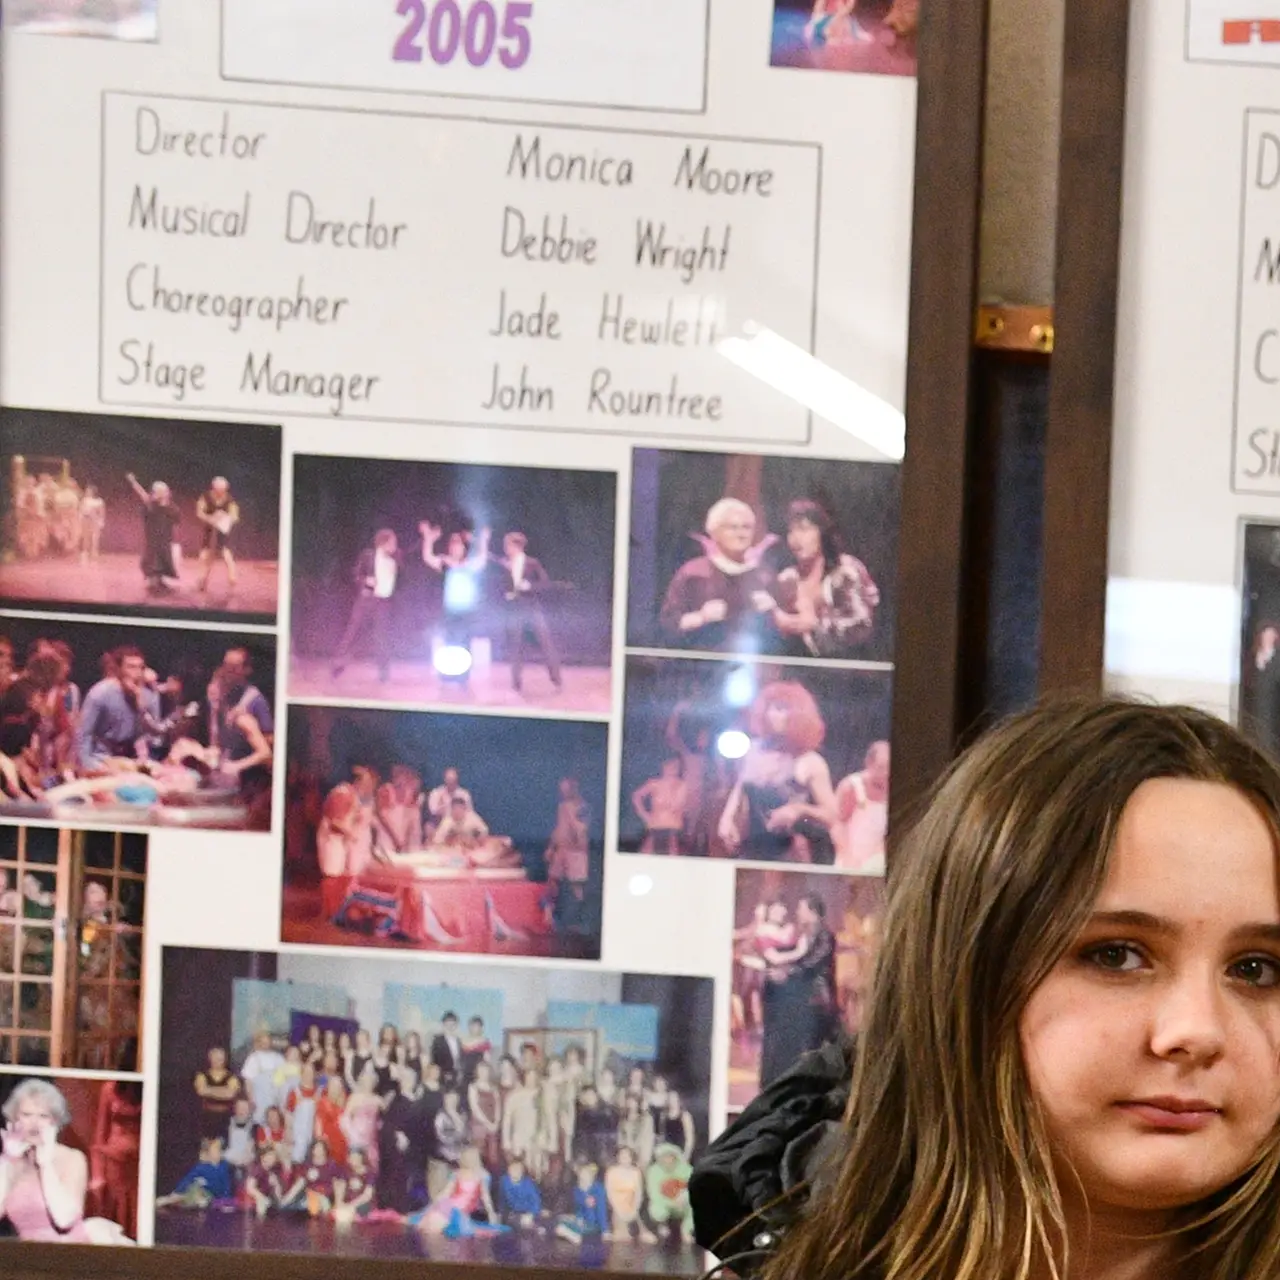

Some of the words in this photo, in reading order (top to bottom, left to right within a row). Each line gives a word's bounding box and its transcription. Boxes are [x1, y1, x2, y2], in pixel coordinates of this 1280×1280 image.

[392, 0, 533, 69] 2005
[136, 106, 266, 158] Director
[506, 134, 633, 187] Monica
[674, 144, 774, 196] Moore
[128, 184, 251, 238] Musical
[284, 189, 407, 250] Director
[500, 205, 597, 265] Debbie
[635, 217, 731, 285] Wright
[125, 262, 349, 333] Choreographer
[489, 288, 561, 340] Jade
[117, 338, 206, 400] Stage
[239, 351, 380, 416] Manager
[482, 362, 553, 411] John
[588, 367, 723, 421] Rountree
